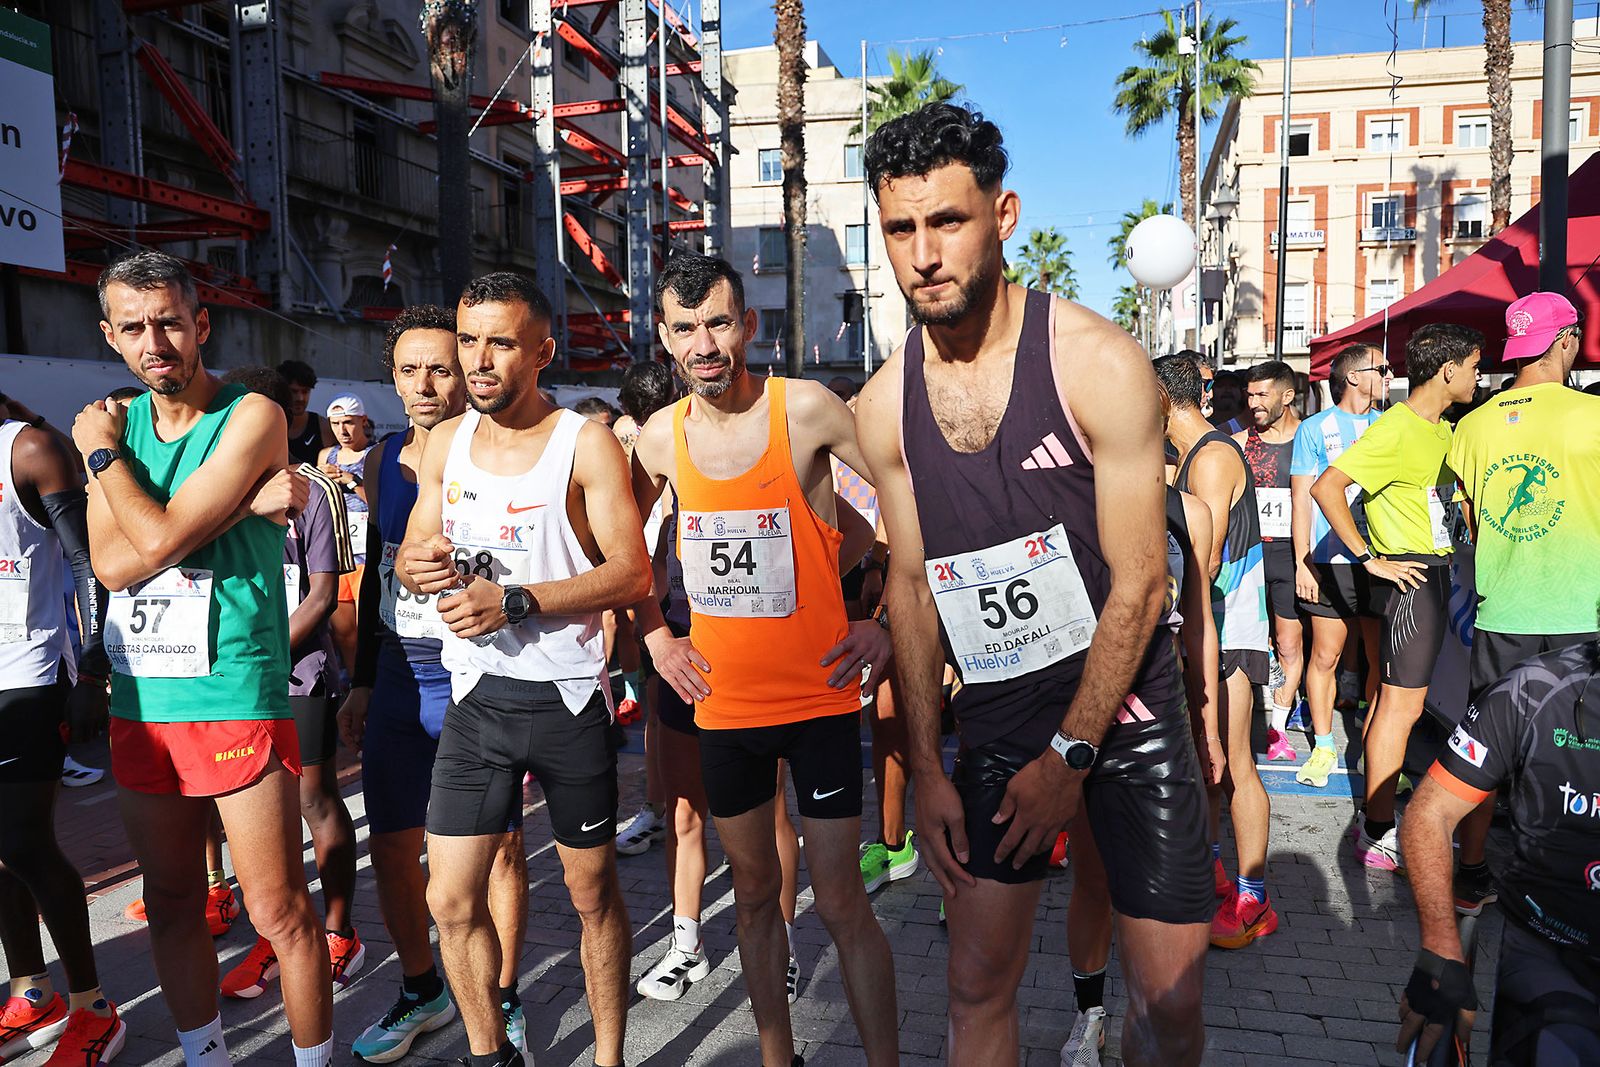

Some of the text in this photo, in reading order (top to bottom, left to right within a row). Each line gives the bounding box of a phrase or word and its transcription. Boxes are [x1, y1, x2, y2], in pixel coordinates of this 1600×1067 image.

[1501, 453, 1560, 479] ATLETISMO
[463, 490, 477, 501] NN
[1261, 501, 1282, 518] 41
[1548, 499, 1566, 527] CEPA
[687, 515, 704, 533] 21K
[757, 512, 781, 530] 21K
[1481, 508, 1549, 543] RUNNERS PURA
[500, 525, 522, 543] 21K
[1024, 534, 1057, 559] 21K
[710, 540, 757, 577] 54
[1030, 550, 1060, 567] HUELVA
[934, 561, 963, 581] 21K
[990, 566, 1015, 576] HUELVA
[707, 586, 760, 595] MARHOUM
[940, 579, 966, 590] HUELVA
[691, 593, 733, 607] Huelva
[978, 578, 1039, 630] 56
[129, 599, 171, 634] 57
[984, 624, 1051, 655] ED DAFALI
[1002, 624, 1029, 638] MOURAD
[142, 644, 197, 654] CARDOZO
[964, 652, 1021, 671] Huelva
